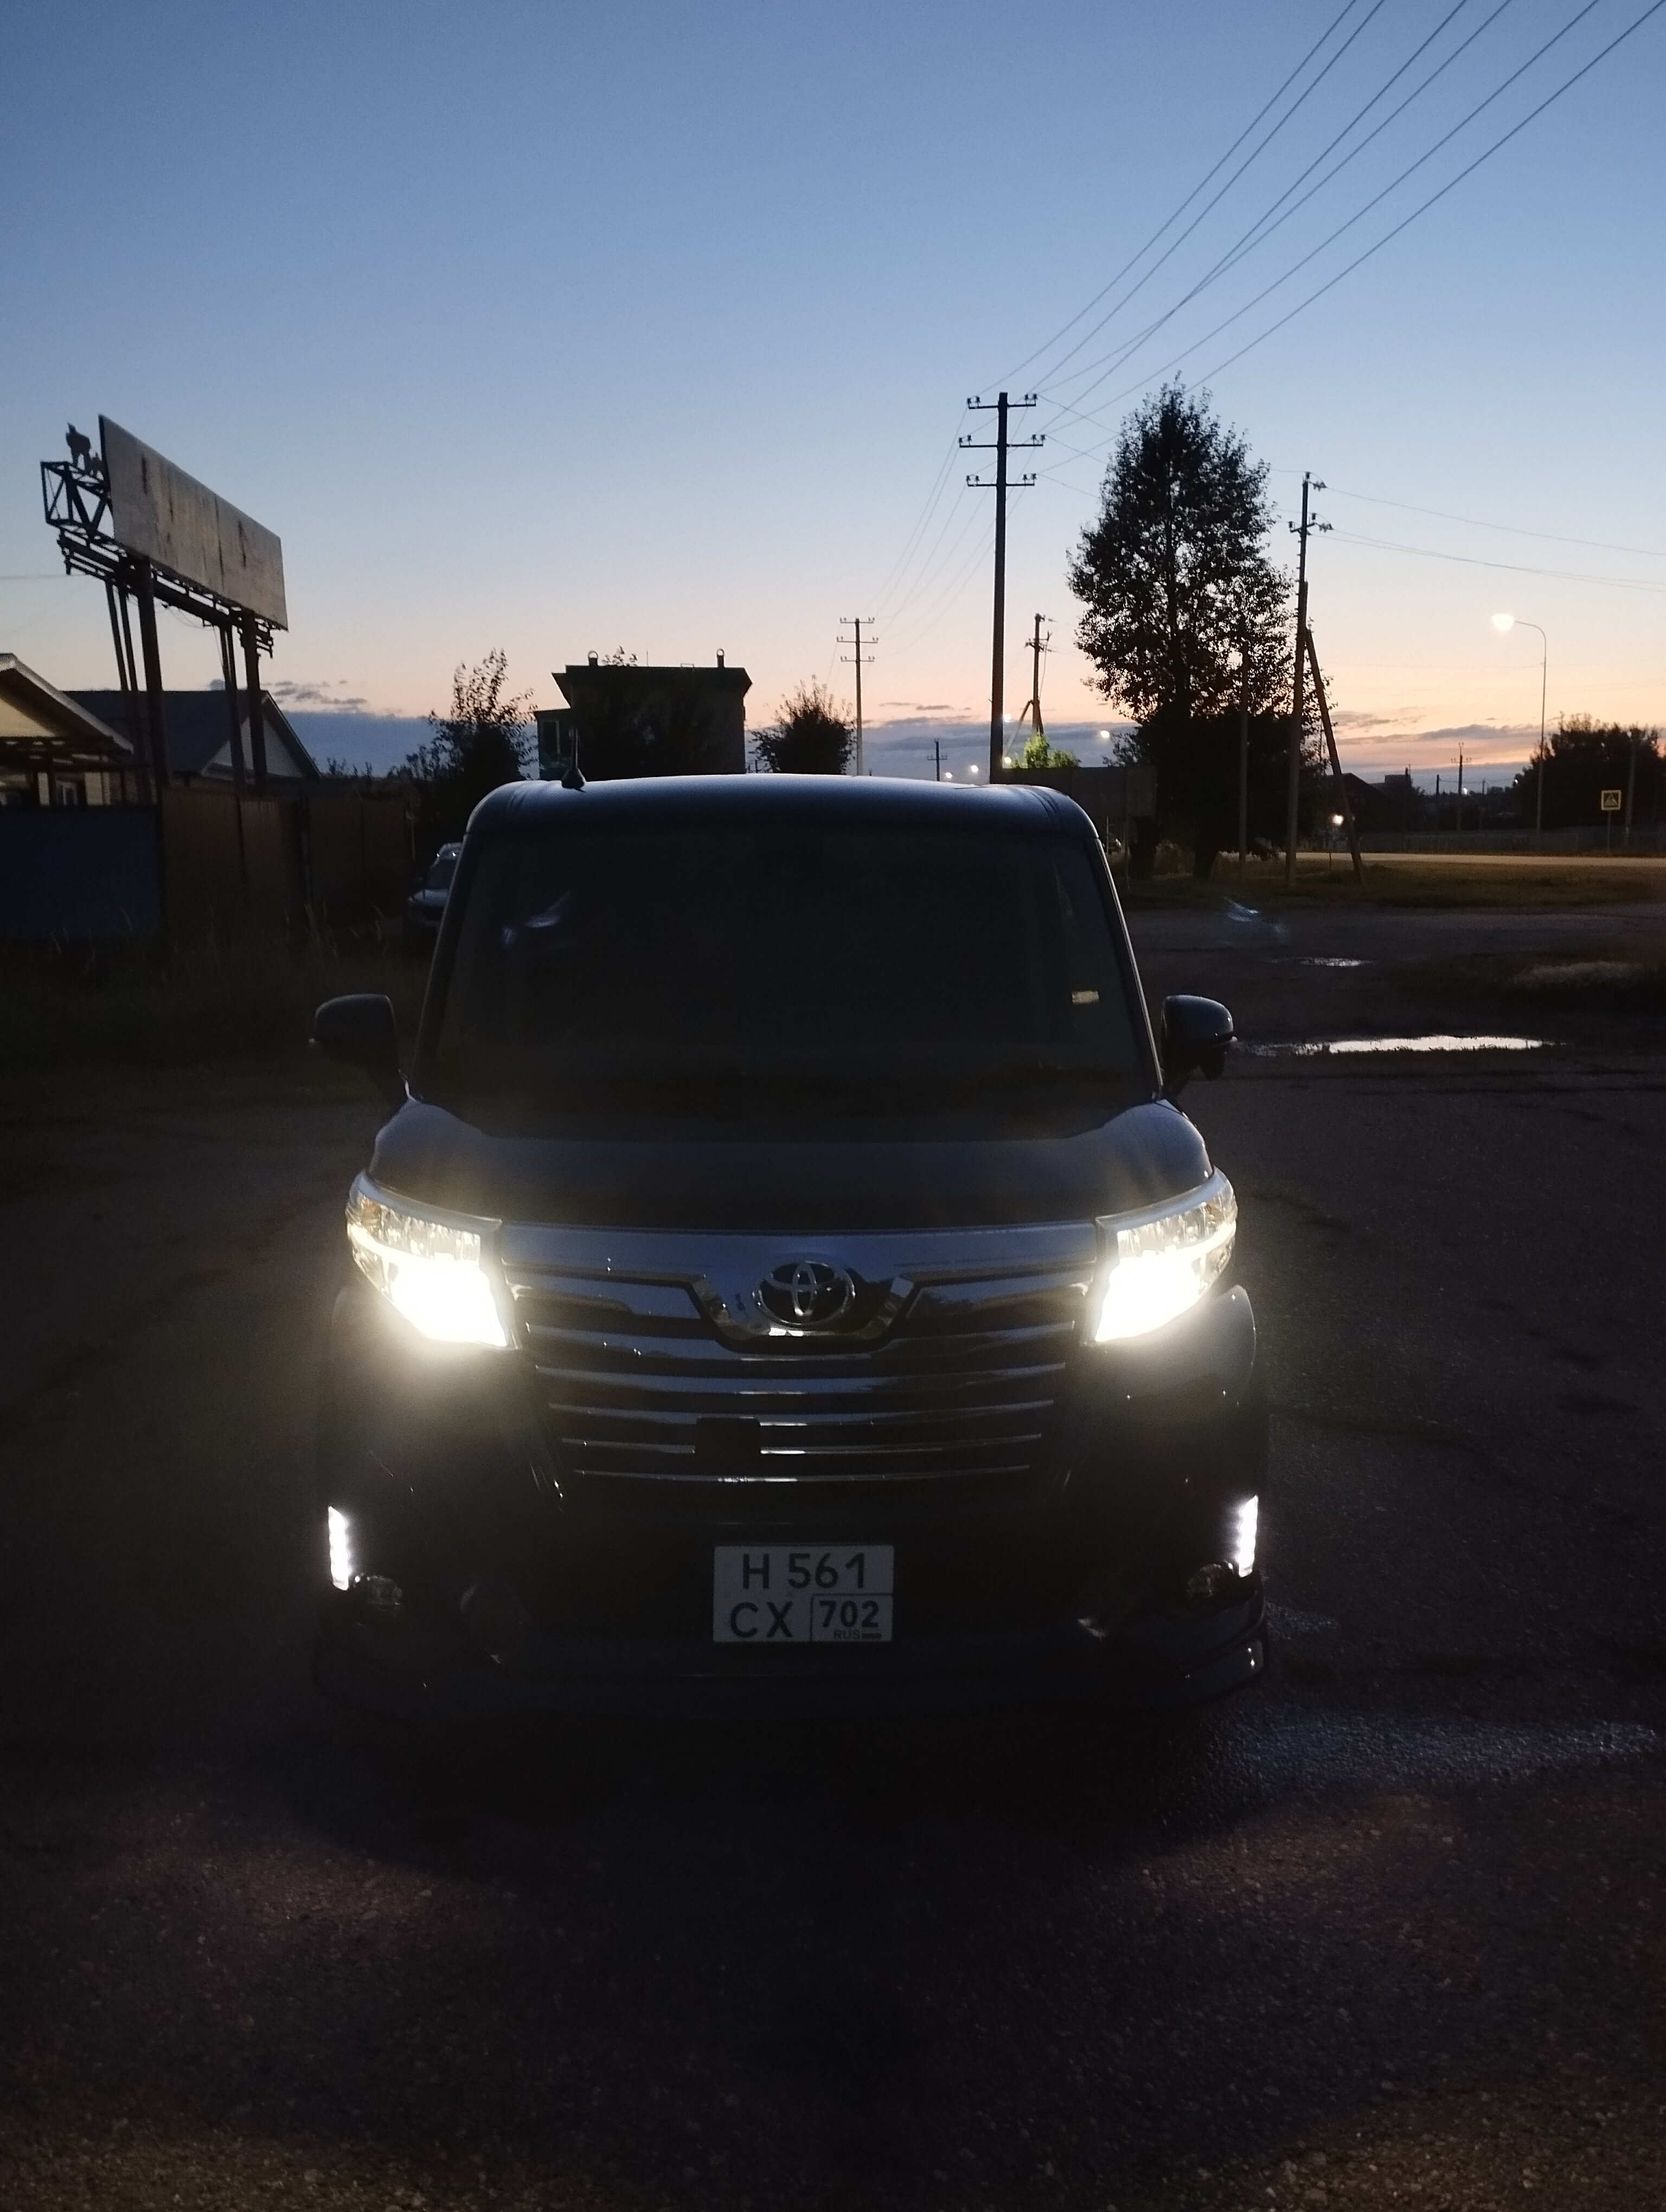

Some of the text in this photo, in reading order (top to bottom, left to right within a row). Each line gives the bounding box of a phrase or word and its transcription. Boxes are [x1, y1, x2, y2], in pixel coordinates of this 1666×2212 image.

[730, 1600, 793, 1638] CX
[819, 1600, 879, 1628] 702
[834, 1629, 861, 1640] RUS
